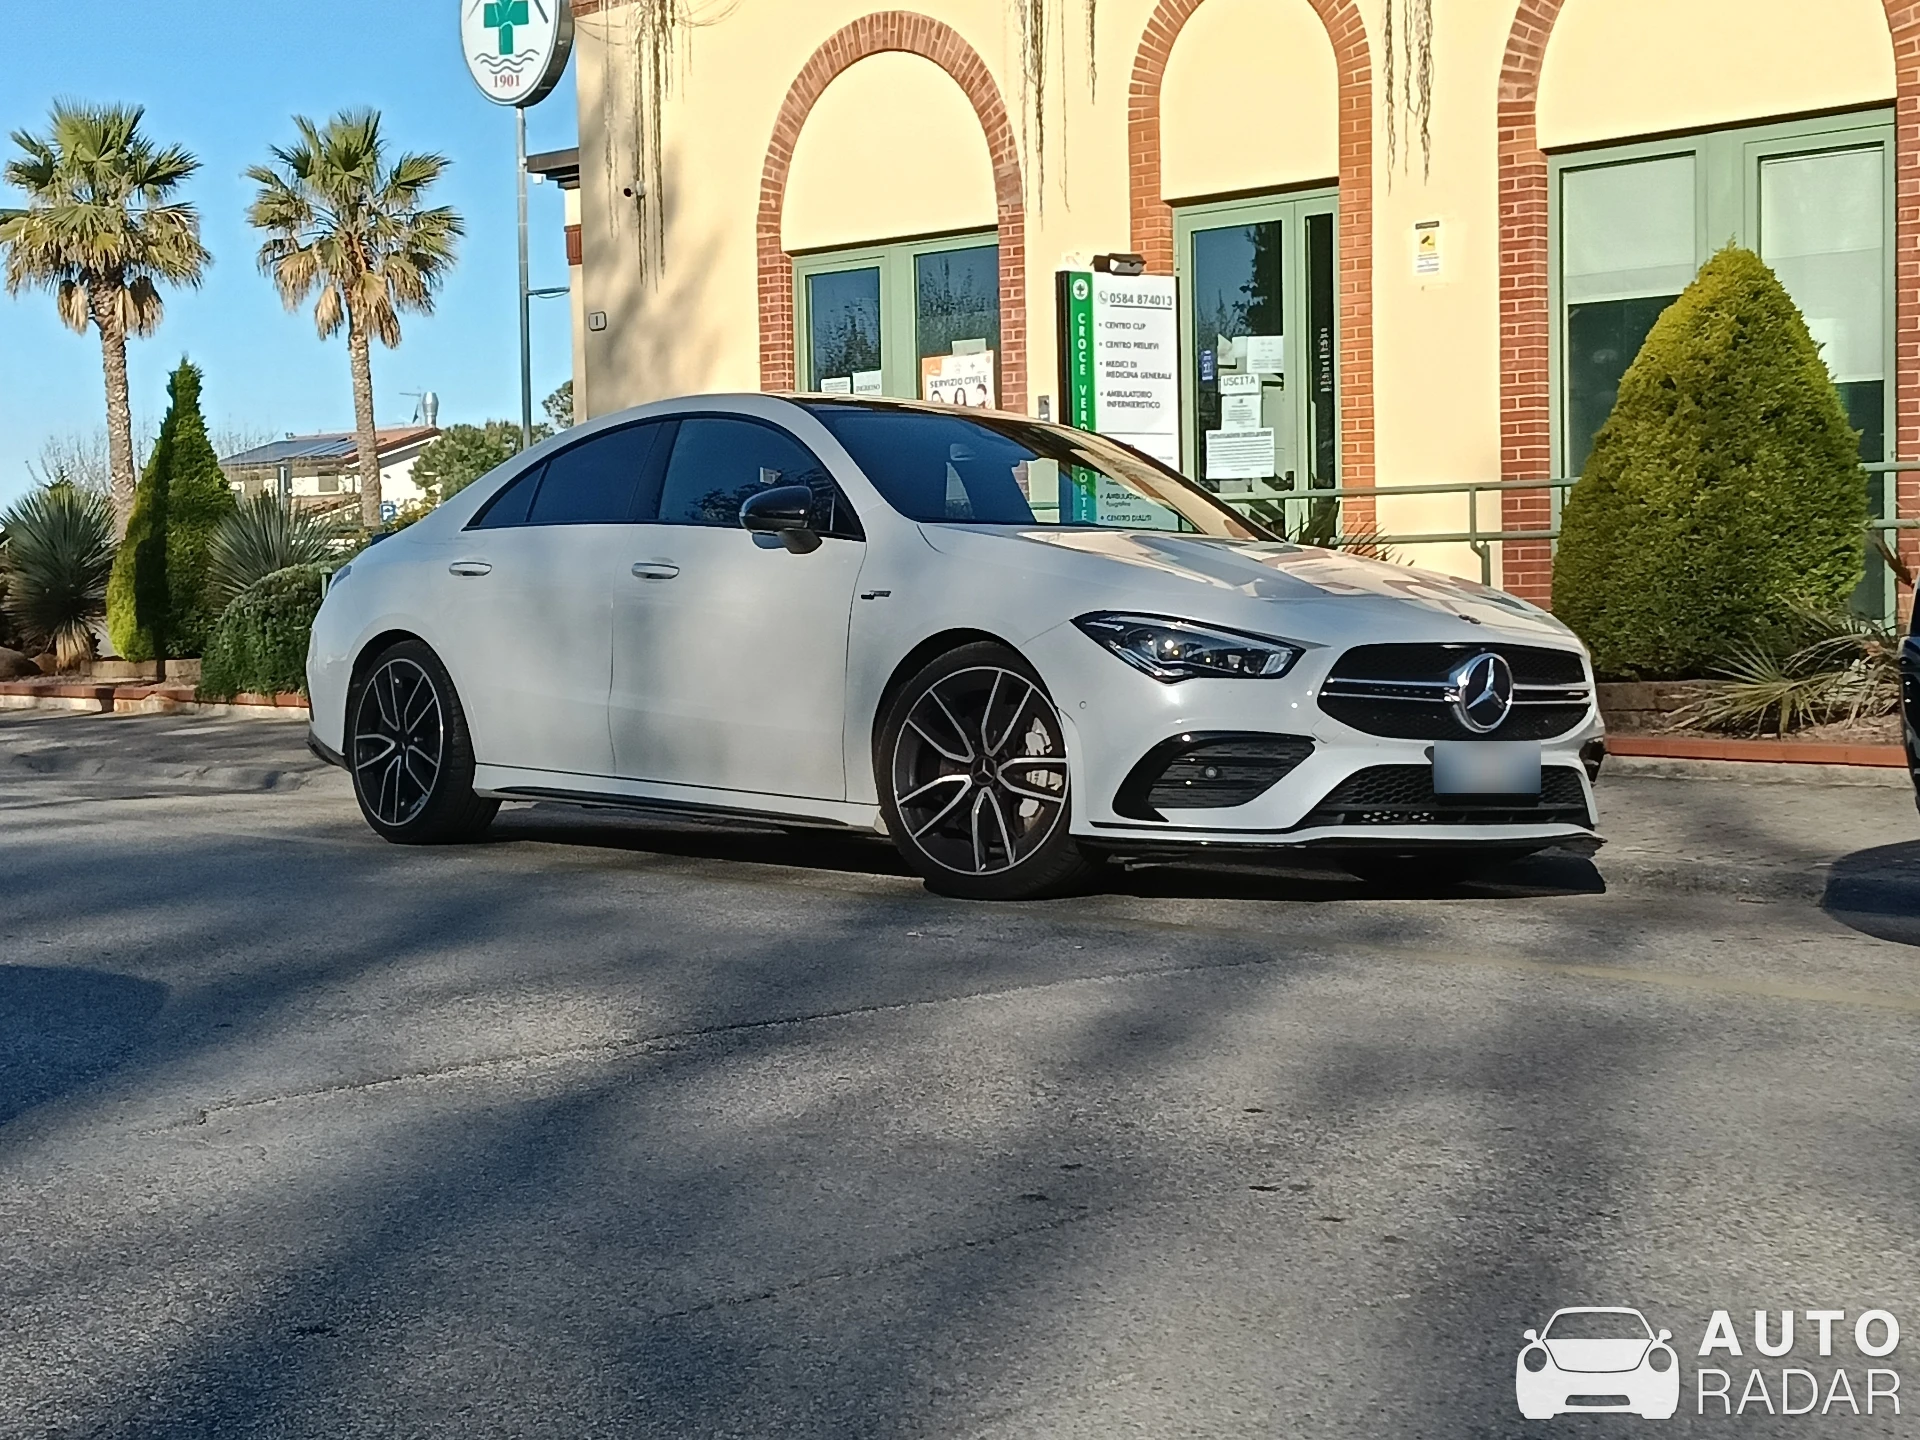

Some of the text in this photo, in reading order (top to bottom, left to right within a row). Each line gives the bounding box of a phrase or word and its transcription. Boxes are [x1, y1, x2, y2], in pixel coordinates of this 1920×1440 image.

[493, 75, 520, 88] 1901
[1110, 293, 1173, 306] 0584 874013
[1105, 321, 1132, 330] CENTRO
[1105, 341, 1132, 349] CENTRO
[1105, 360, 1138, 369] MEDICI DI
[930, 374, 988, 388] SERVIZIO CIVILE
[1106, 370, 1173, 380] MEDICINA GENERALE
[1223, 375, 1256, 387] USCITA
[1106, 390, 1153, 398] AMBULATORIO
[1077, 312, 1089, 521] CROCE VERD ORTE
[382, 504, 395, 521] P
